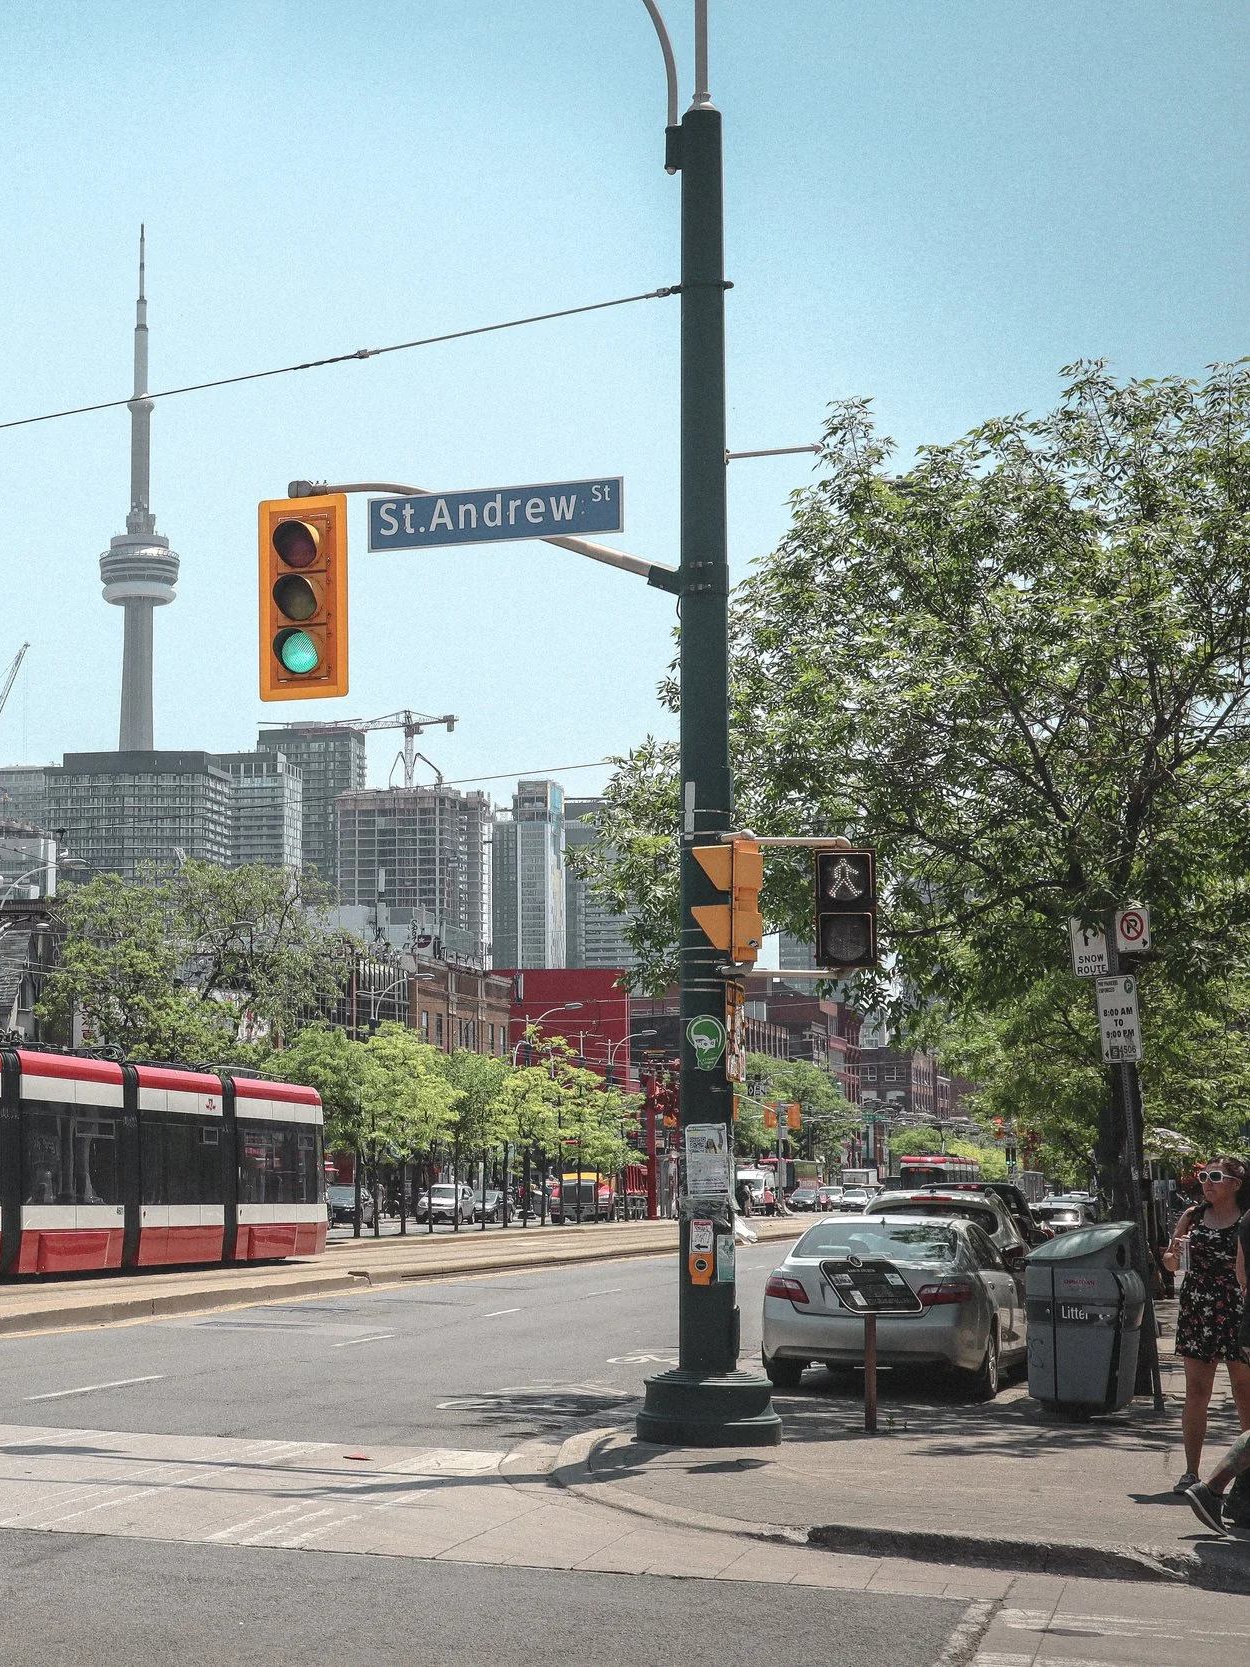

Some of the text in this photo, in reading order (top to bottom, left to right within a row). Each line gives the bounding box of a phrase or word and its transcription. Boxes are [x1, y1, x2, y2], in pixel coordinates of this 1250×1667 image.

[379, 484, 611, 536] St.Andrew St
[1078, 953, 1104, 964] SNOW
[1077, 964, 1107, 975] ROUTE
[1103, 1007, 1133, 1017] 8:00 AM
[1113, 1018, 1124, 1027] TO
[1106, 1028, 1135, 1039] 9:00 PM
